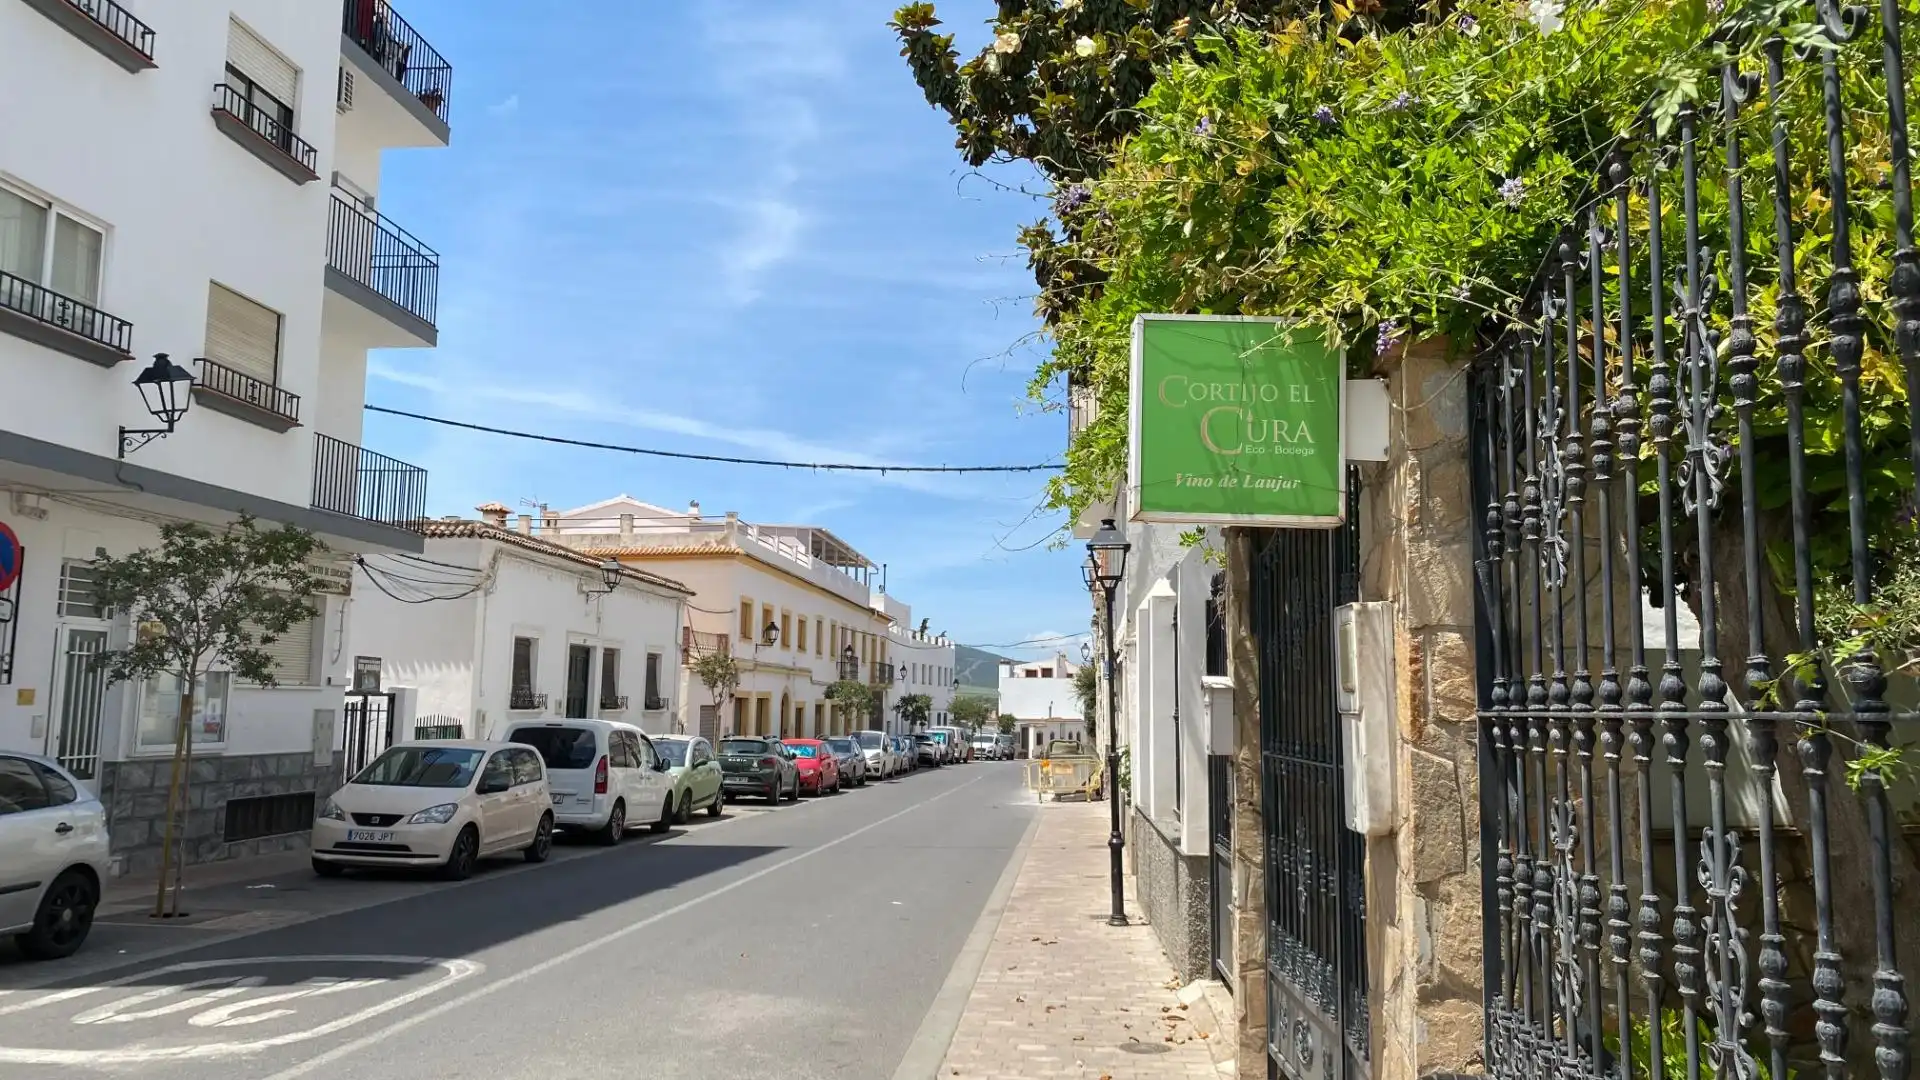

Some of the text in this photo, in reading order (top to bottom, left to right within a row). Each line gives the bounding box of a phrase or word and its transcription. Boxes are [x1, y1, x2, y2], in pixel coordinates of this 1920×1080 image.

[1158, 374, 1315, 408] CORTIJO EL
[1200, 405, 1315, 456] CURA
[1245, 444, 1265, 455] Eco
[1275, 445, 1315, 457] Bodega
[1175, 472, 1213, 488] Vino
[1218, 474, 1238, 488] de
[353, 832, 395, 841] 7026 JPT
